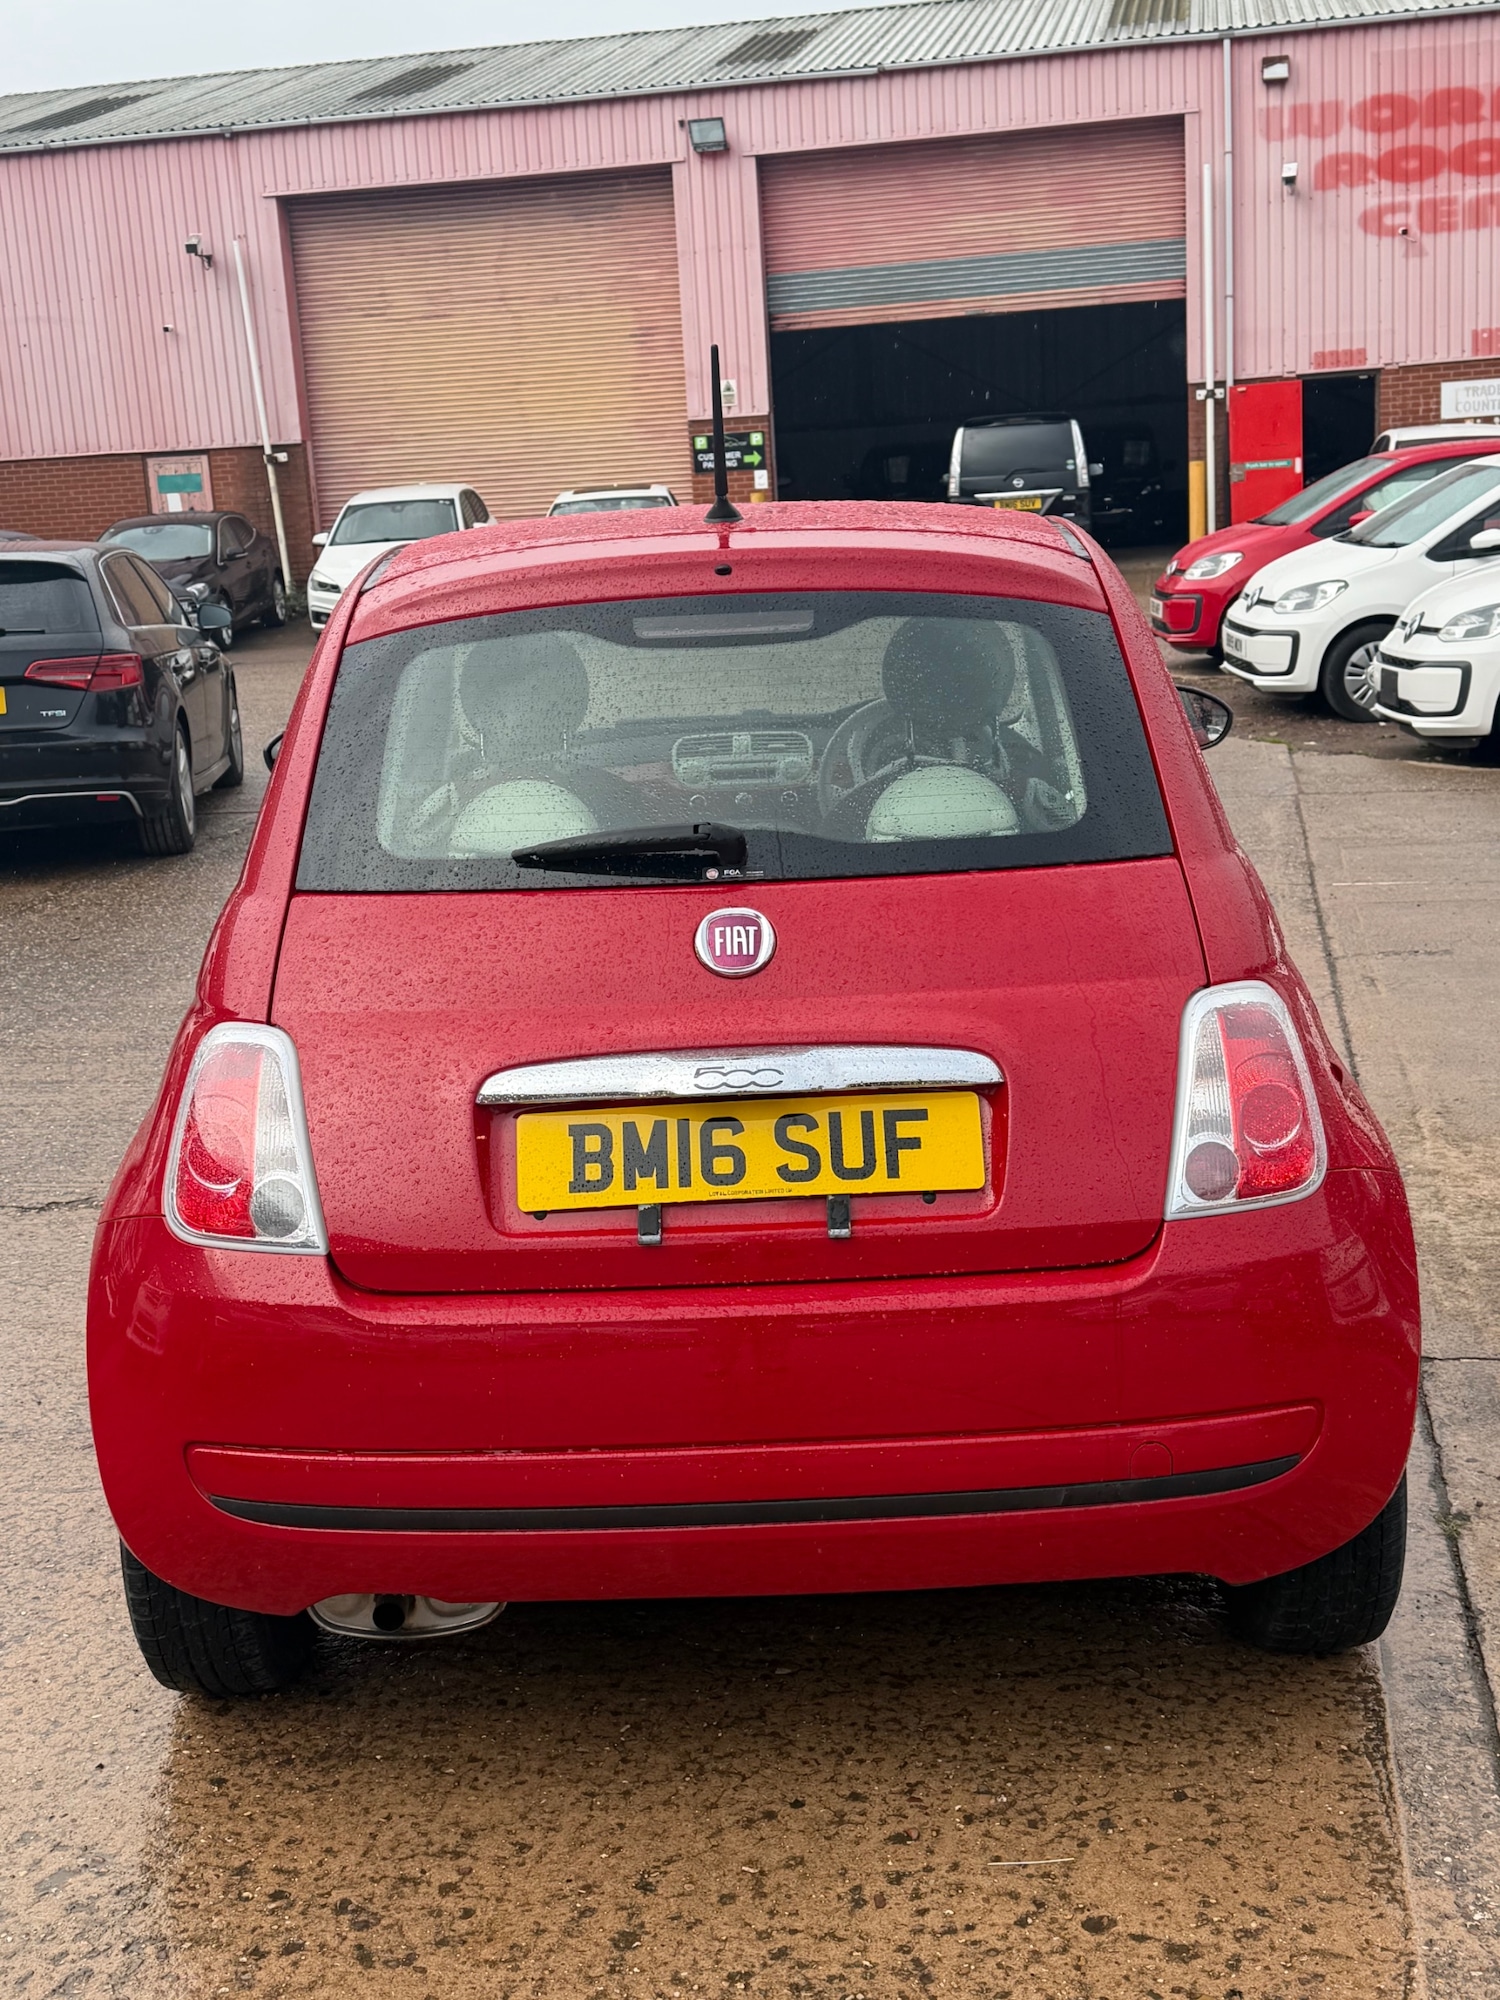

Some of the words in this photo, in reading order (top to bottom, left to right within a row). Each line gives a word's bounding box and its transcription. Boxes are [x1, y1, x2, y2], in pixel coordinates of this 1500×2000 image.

[697, 451, 742, 461] CUSMER
[702, 460, 738, 469] PANG
[714, 926, 758, 957] FIAT
[694, 1066, 784, 1090] 500
[568, 1116, 747, 1193] BM16
[774, 1108, 928, 1183] SUF
